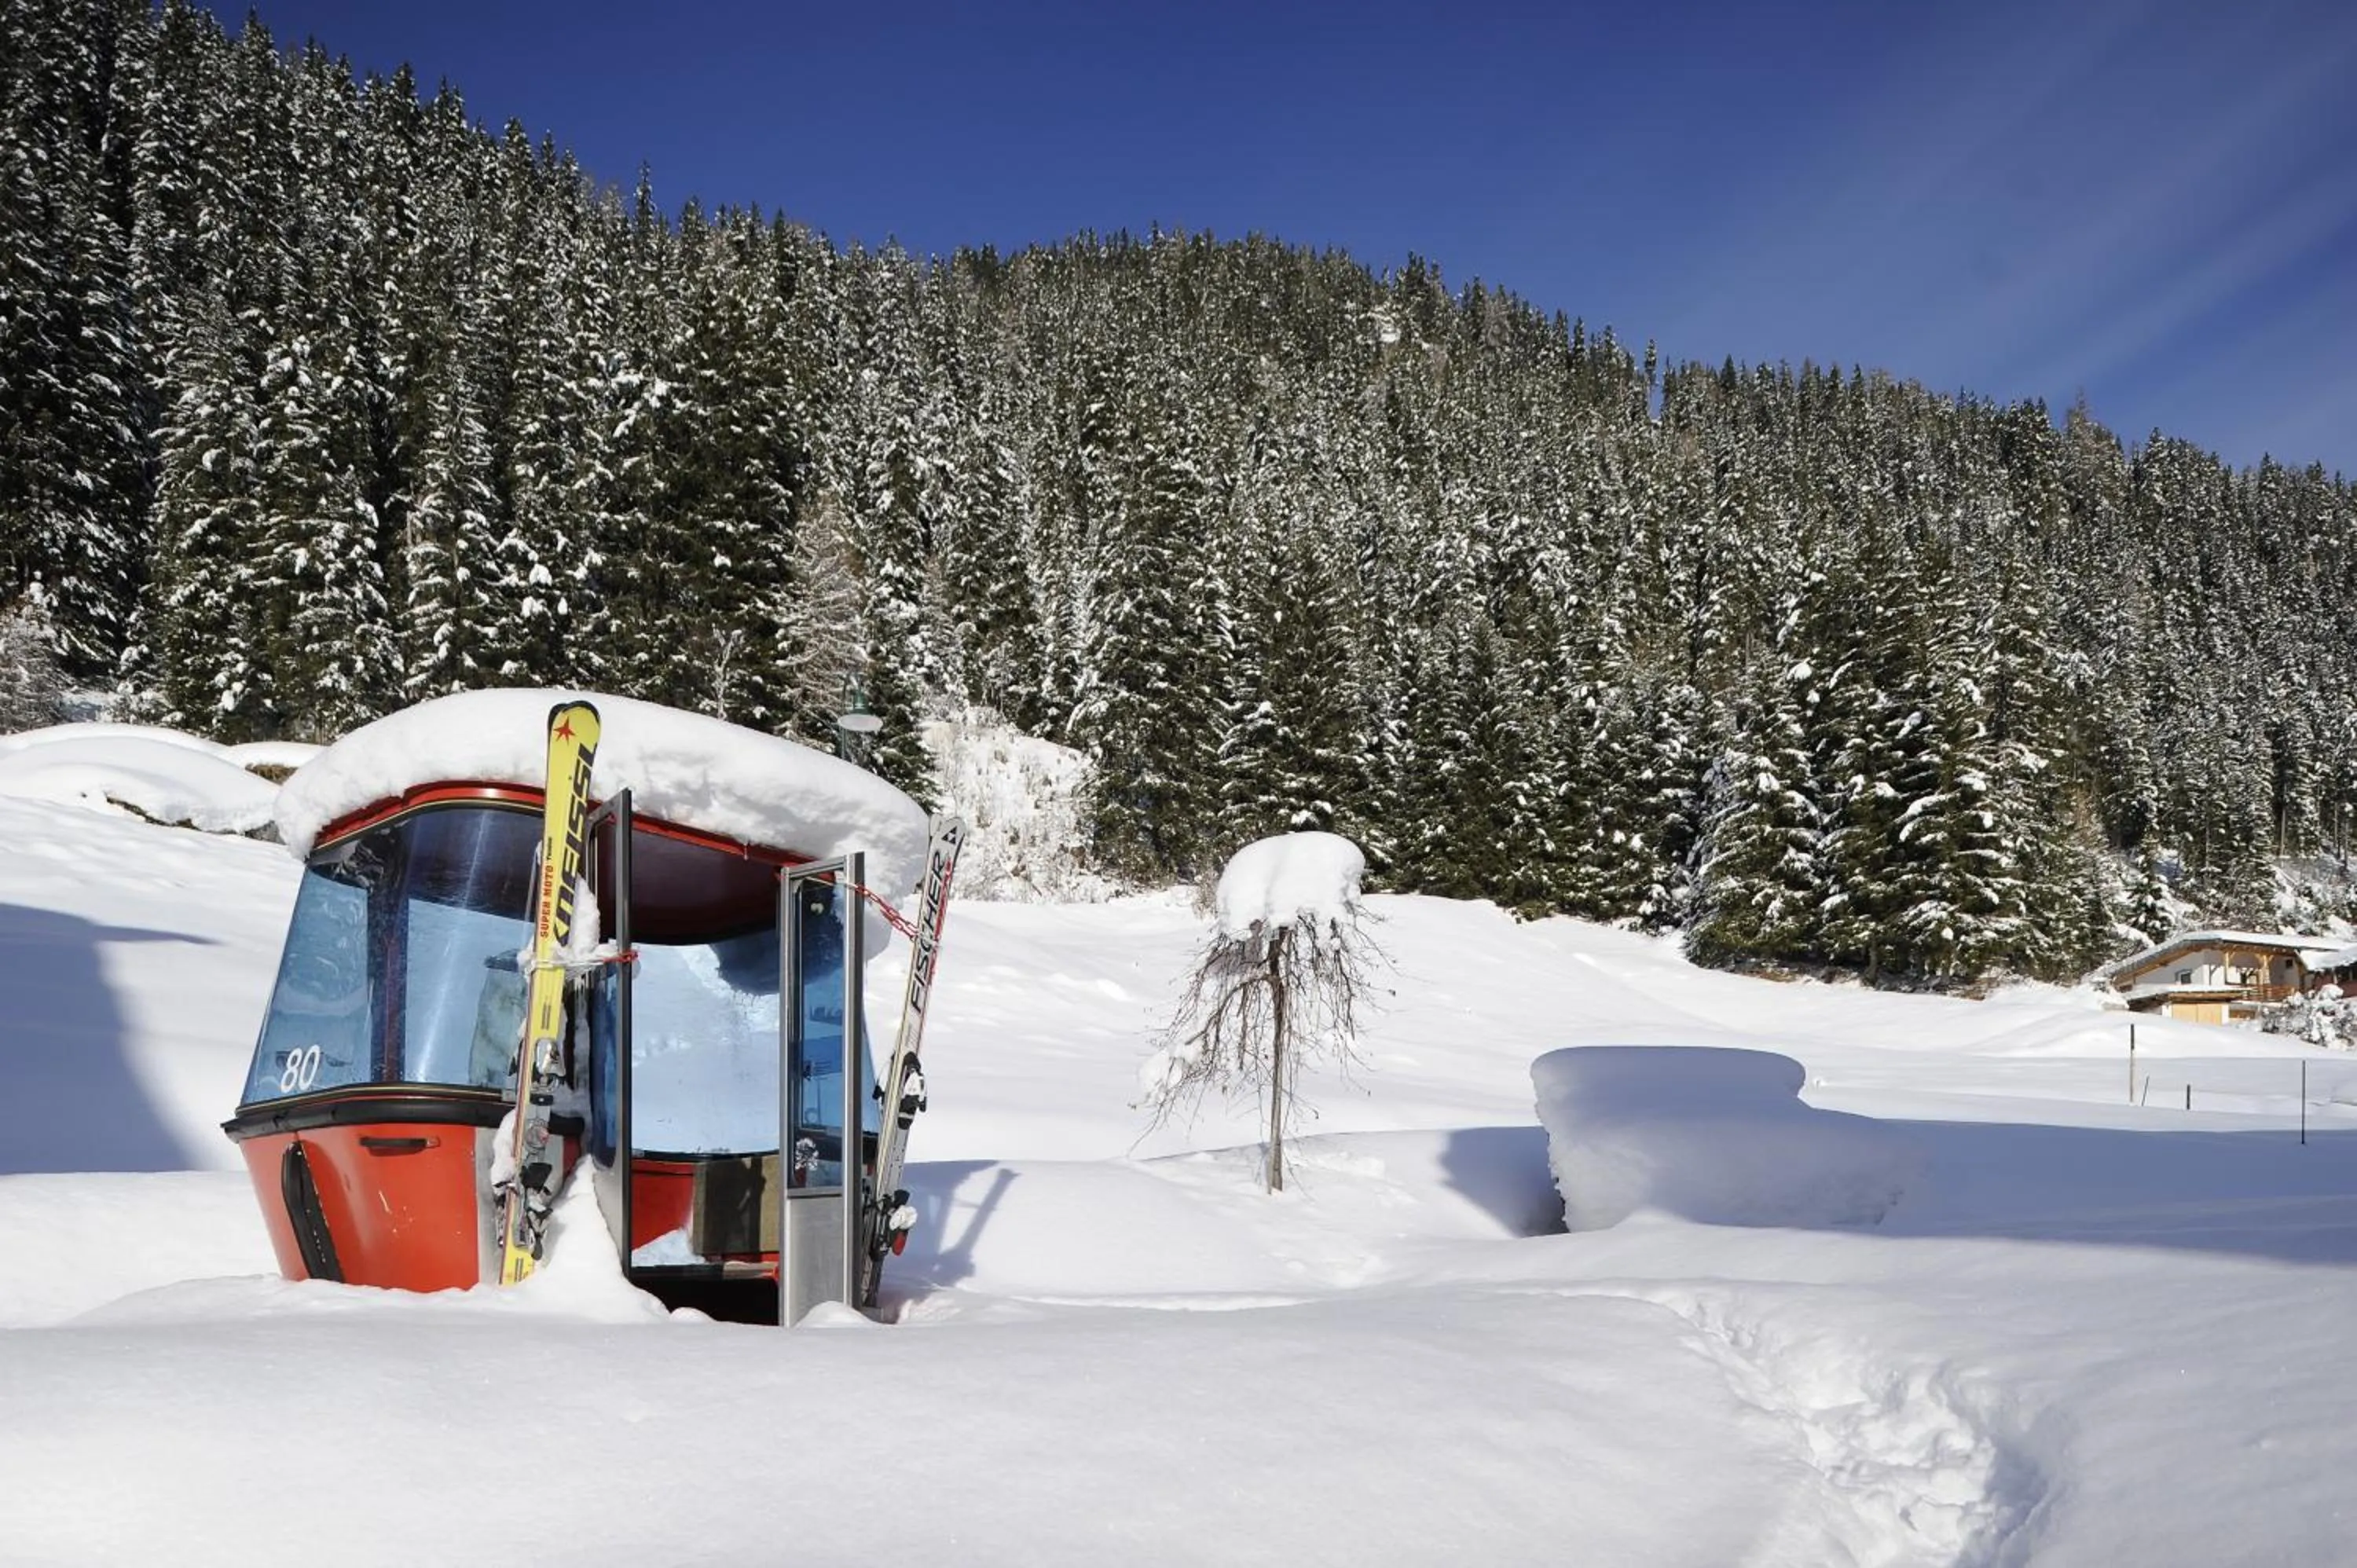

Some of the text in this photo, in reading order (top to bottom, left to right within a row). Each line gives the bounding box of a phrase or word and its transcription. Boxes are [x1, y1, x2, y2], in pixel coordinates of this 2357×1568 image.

[542, 865, 554, 898] MOTO
[540, 901, 552, 938] SUPER
[911, 851, 944, 1013] FISCHER
[280, 1045, 321, 1094] 80
